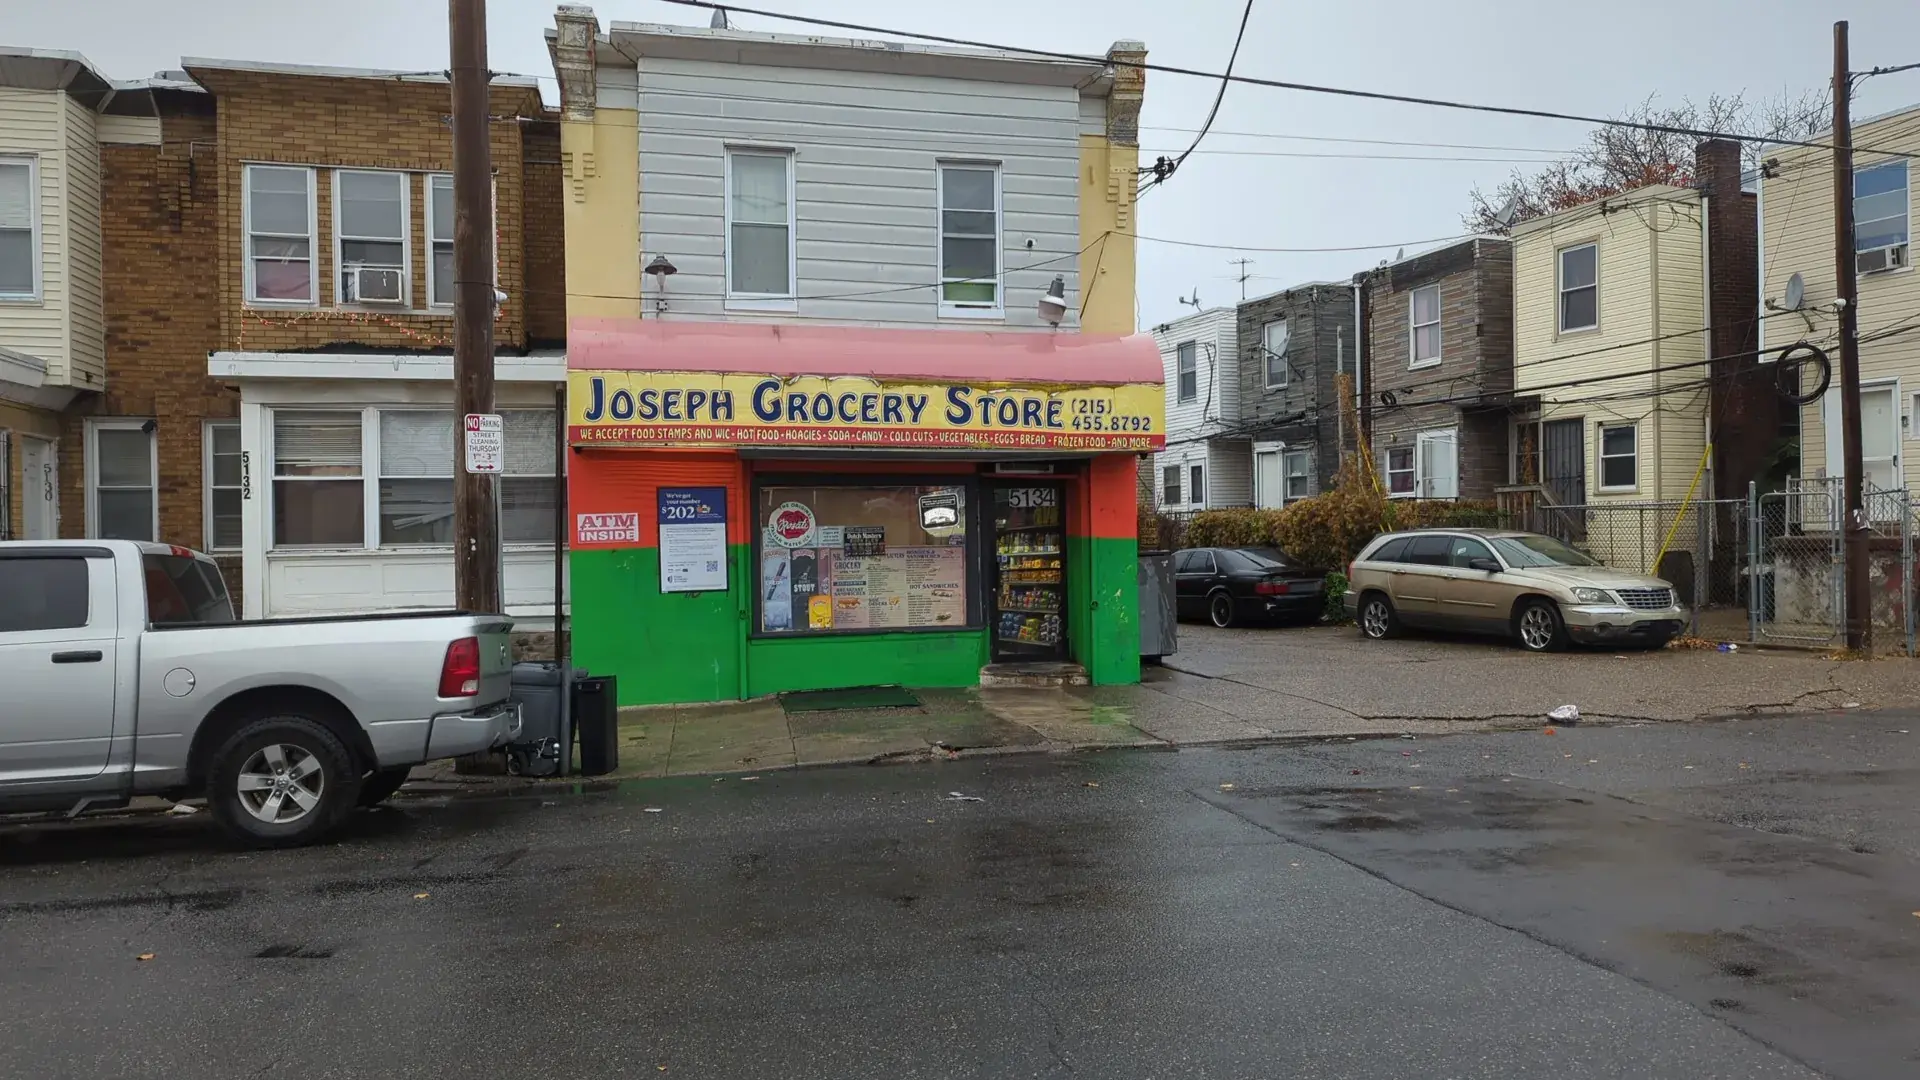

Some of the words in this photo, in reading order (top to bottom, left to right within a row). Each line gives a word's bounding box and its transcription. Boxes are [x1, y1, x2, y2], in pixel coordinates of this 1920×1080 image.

[583, 376, 735, 422] JOSEPH
[752, 378, 930, 424] GROCERY
[945, 386, 1064, 429] STORE
[1071, 399, 1114, 415] (215)
[467, 417, 479, 429] NO
[481, 420, 500, 428] PARKING
[1072, 416, 1151, 432] 455.8792
[580, 428, 593, 439] WE
[596, 428, 628, 439] ACCEPT
[631, 428, 655, 439] FOOD
[657, 428, 692, 439] STAMPS
[694, 428, 712, 439] AND
[715, 428, 729, 439] WIC
[737, 428, 754, 440] HOT
[756, 429, 779, 441] FOOD
[785, 429, 822, 441] HOAGIES
[828, 430, 850, 441] SODA
[856, 430, 883, 442] CANDY
[889, 430, 910, 442] COLD
[913, 431, 934, 442] CUTS
[939, 431, 989, 443] VEGETABLES
[994, 432, 1015, 444] EGGS
[1020, 433, 1046, 445] BREAD
[1053, 435, 1084, 447] FROZEN
[1085, 436, 1107, 447] FOOD
[1111, 436, 1128, 448] AND
[469, 445, 500, 453] THURSDAY
[44, 463, 53, 501] 5130
[242, 451, 251, 499] 5132
[1009, 488, 1055, 507] 5134
[579, 514, 636, 529] ATM
[579, 530, 636, 541] INSIDE
[834, 561, 861, 570] GROCERY
[793, 583, 815, 593] STOUT
